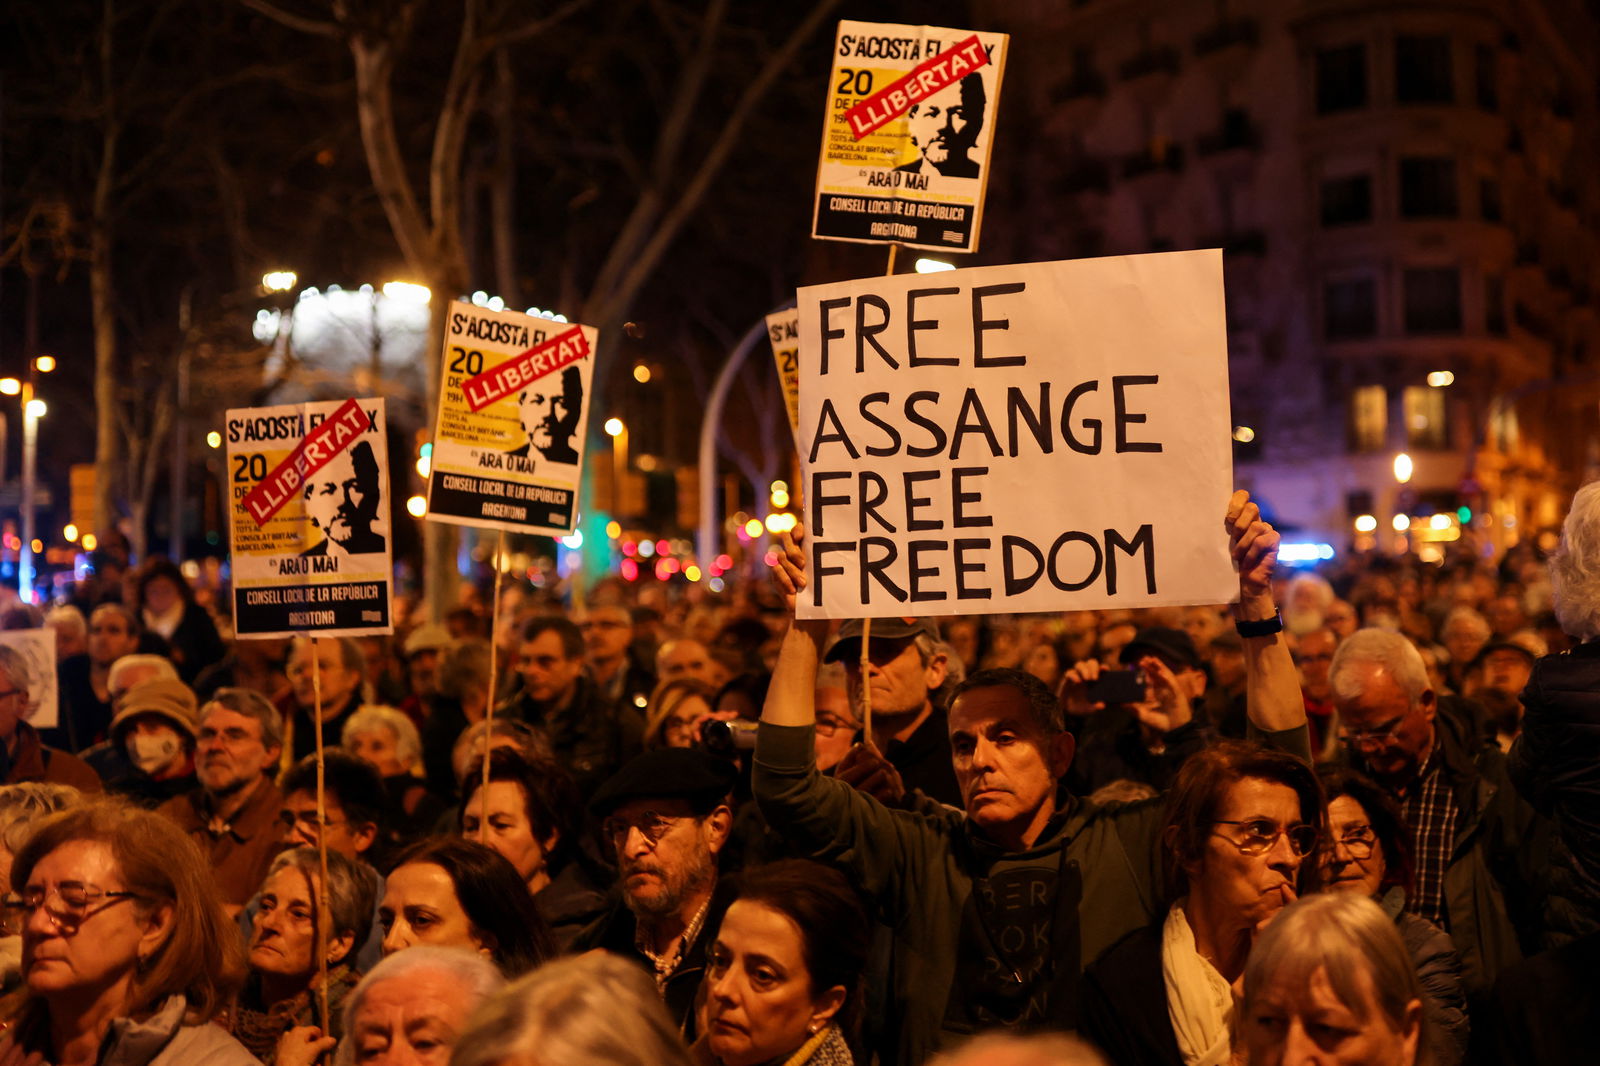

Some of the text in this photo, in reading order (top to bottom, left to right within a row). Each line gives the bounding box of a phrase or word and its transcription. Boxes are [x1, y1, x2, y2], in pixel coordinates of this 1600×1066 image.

[837, 69, 873, 95] 20
[852, 43, 980, 133] LLIBERTAT
[867, 171, 891, 187] ARA
[830, 197, 866, 213] CONSELL
[904, 203, 917, 217] LA
[819, 282, 1027, 376] FREE
[450, 347, 484, 376] 20
[468, 333, 583, 406] LLIBERTAT
[808, 374, 1163, 463] ASSANGE
[233, 453, 267, 482] 20
[252, 407, 362, 518] LLIBERTAT
[478, 452, 502, 470] ARA
[443, 475, 478, 493] CONSELL
[479, 480, 505, 497] LOCAL
[515, 485, 525, 499] LA
[812, 466, 993, 536] FREE
[279, 558, 300, 575] ARA
[813, 523, 1158, 607] FREEDOM
[247, 589, 282, 605] CONSELL
[317, 587, 329, 602] LA
